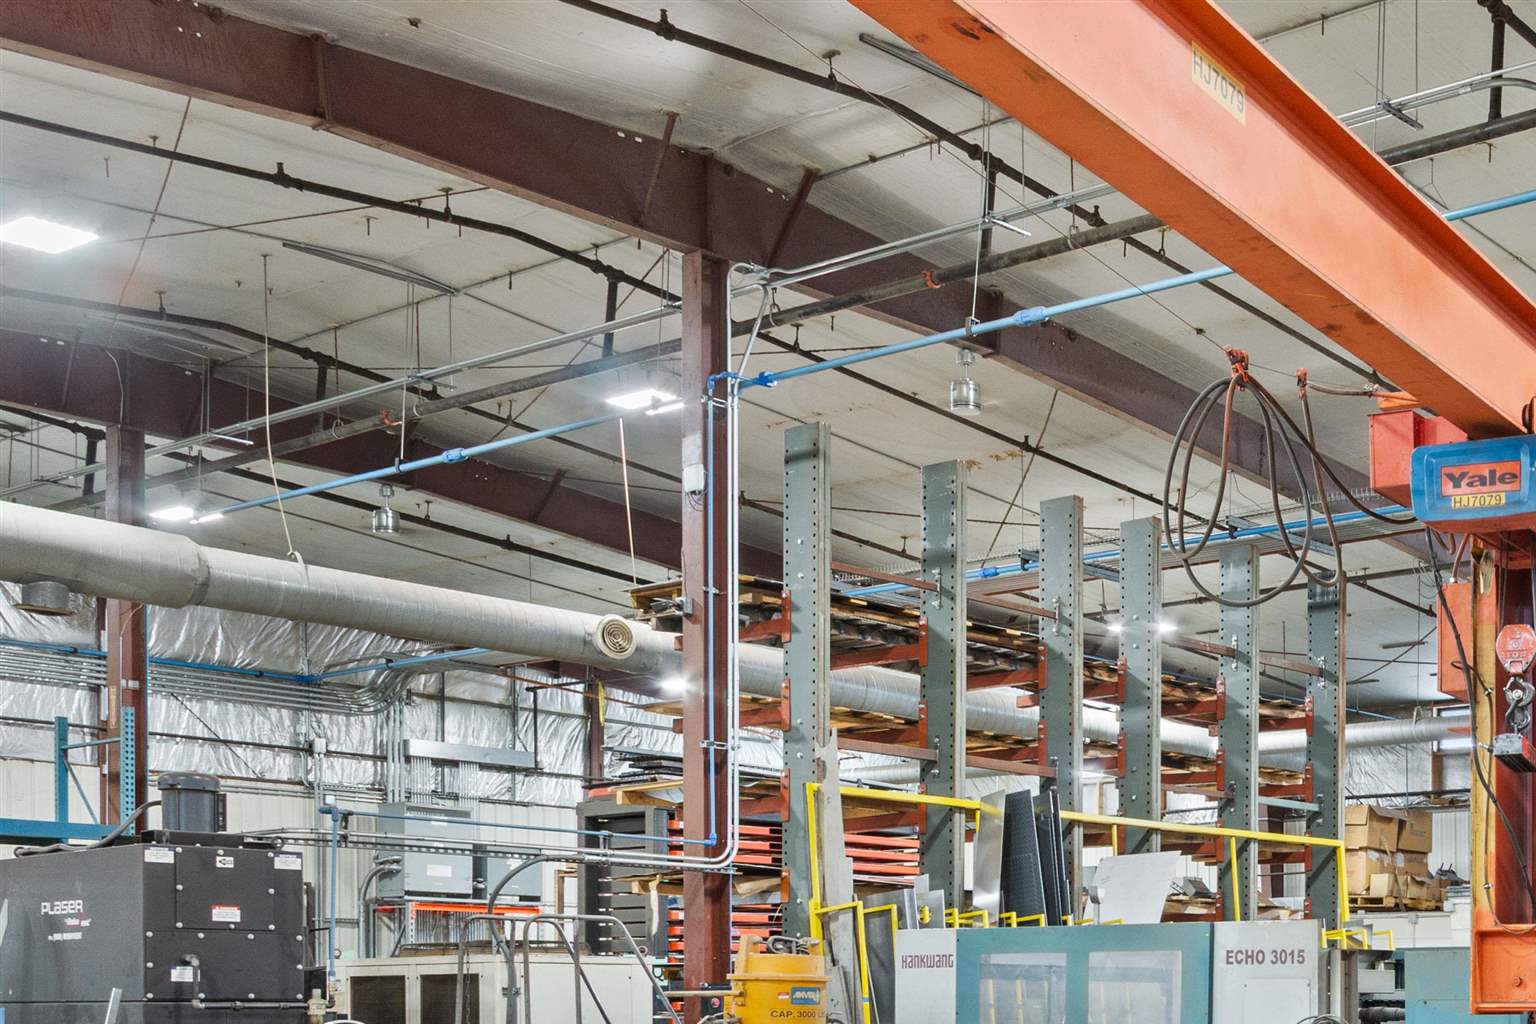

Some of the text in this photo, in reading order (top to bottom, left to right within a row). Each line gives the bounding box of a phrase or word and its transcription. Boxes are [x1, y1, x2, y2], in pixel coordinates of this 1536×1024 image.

[1193, 49, 1244, 113] HJ7079
[1444, 469, 1519, 489] Yale
[1453, 494, 1502, 508] HJ7079
[1226, 949, 1305, 965] ECHO 3015
[770, 1010, 795, 1018] CAP.
